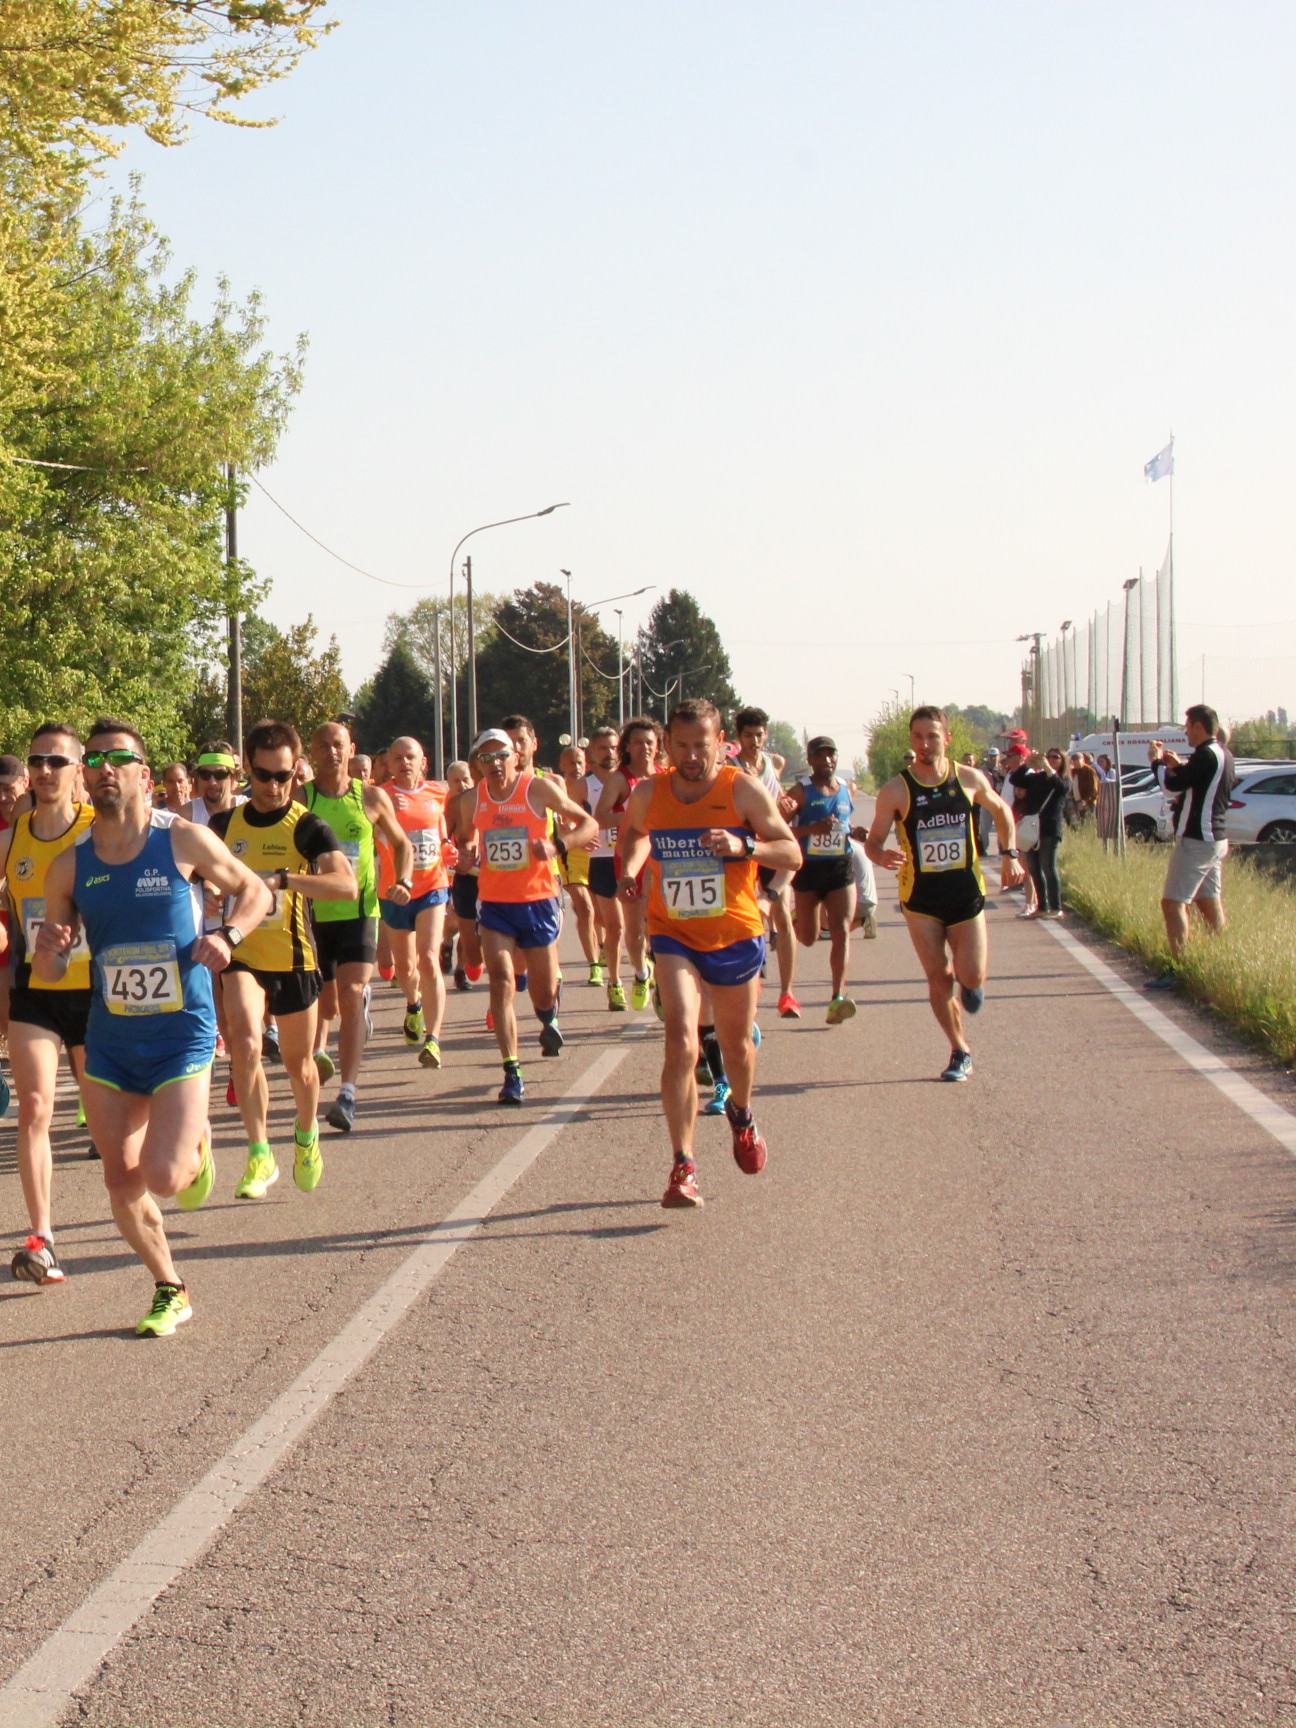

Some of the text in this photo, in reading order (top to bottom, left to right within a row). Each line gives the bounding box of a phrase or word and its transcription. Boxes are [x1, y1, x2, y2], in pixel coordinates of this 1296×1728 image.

[916, 812, 966, 830] AdBlue
[655, 836, 704, 850] libert
[812, 833, 841, 848] 384
[488, 842, 522, 862] 253
[924, 842, 960, 863] 208
[144, 868, 160, 877] G.P.
[136, 876, 169, 888] AVIS
[667, 878, 717, 907] 715
[111, 966, 171, 1001] 432
